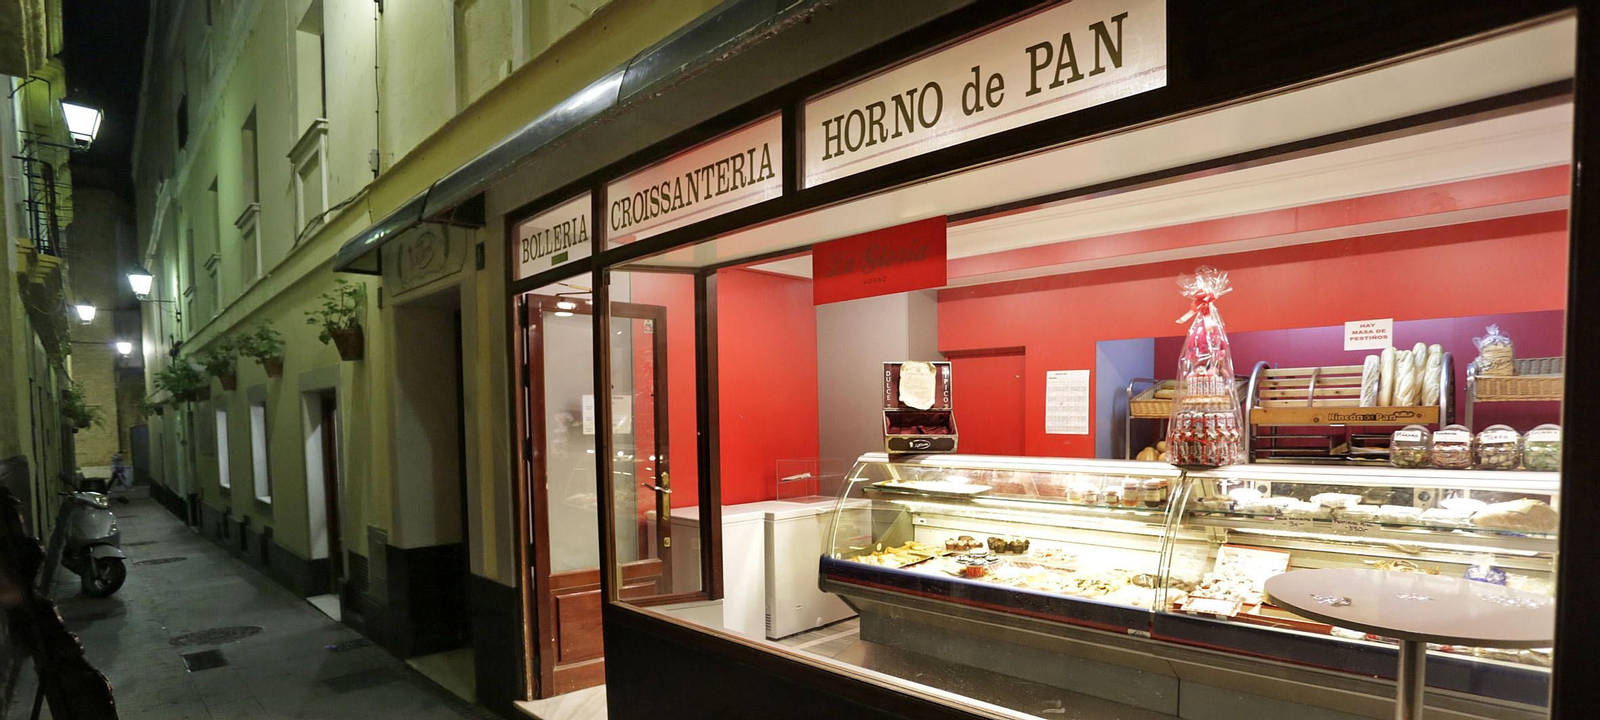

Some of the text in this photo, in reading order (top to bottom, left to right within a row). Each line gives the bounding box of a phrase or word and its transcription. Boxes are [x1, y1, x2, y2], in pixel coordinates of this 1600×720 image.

[821, 11, 1129, 161] HORNO de PAN
[611, 142, 775, 232] CROISSANTERIA
[521, 214, 589, 264] BOLLERIA
[861, 238, 930, 274] Gloria
[863, 276, 887, 285] HORNO
[1328, 413, 1363, 421] Rincón
[1376, 413, 1396, 421] Pan
